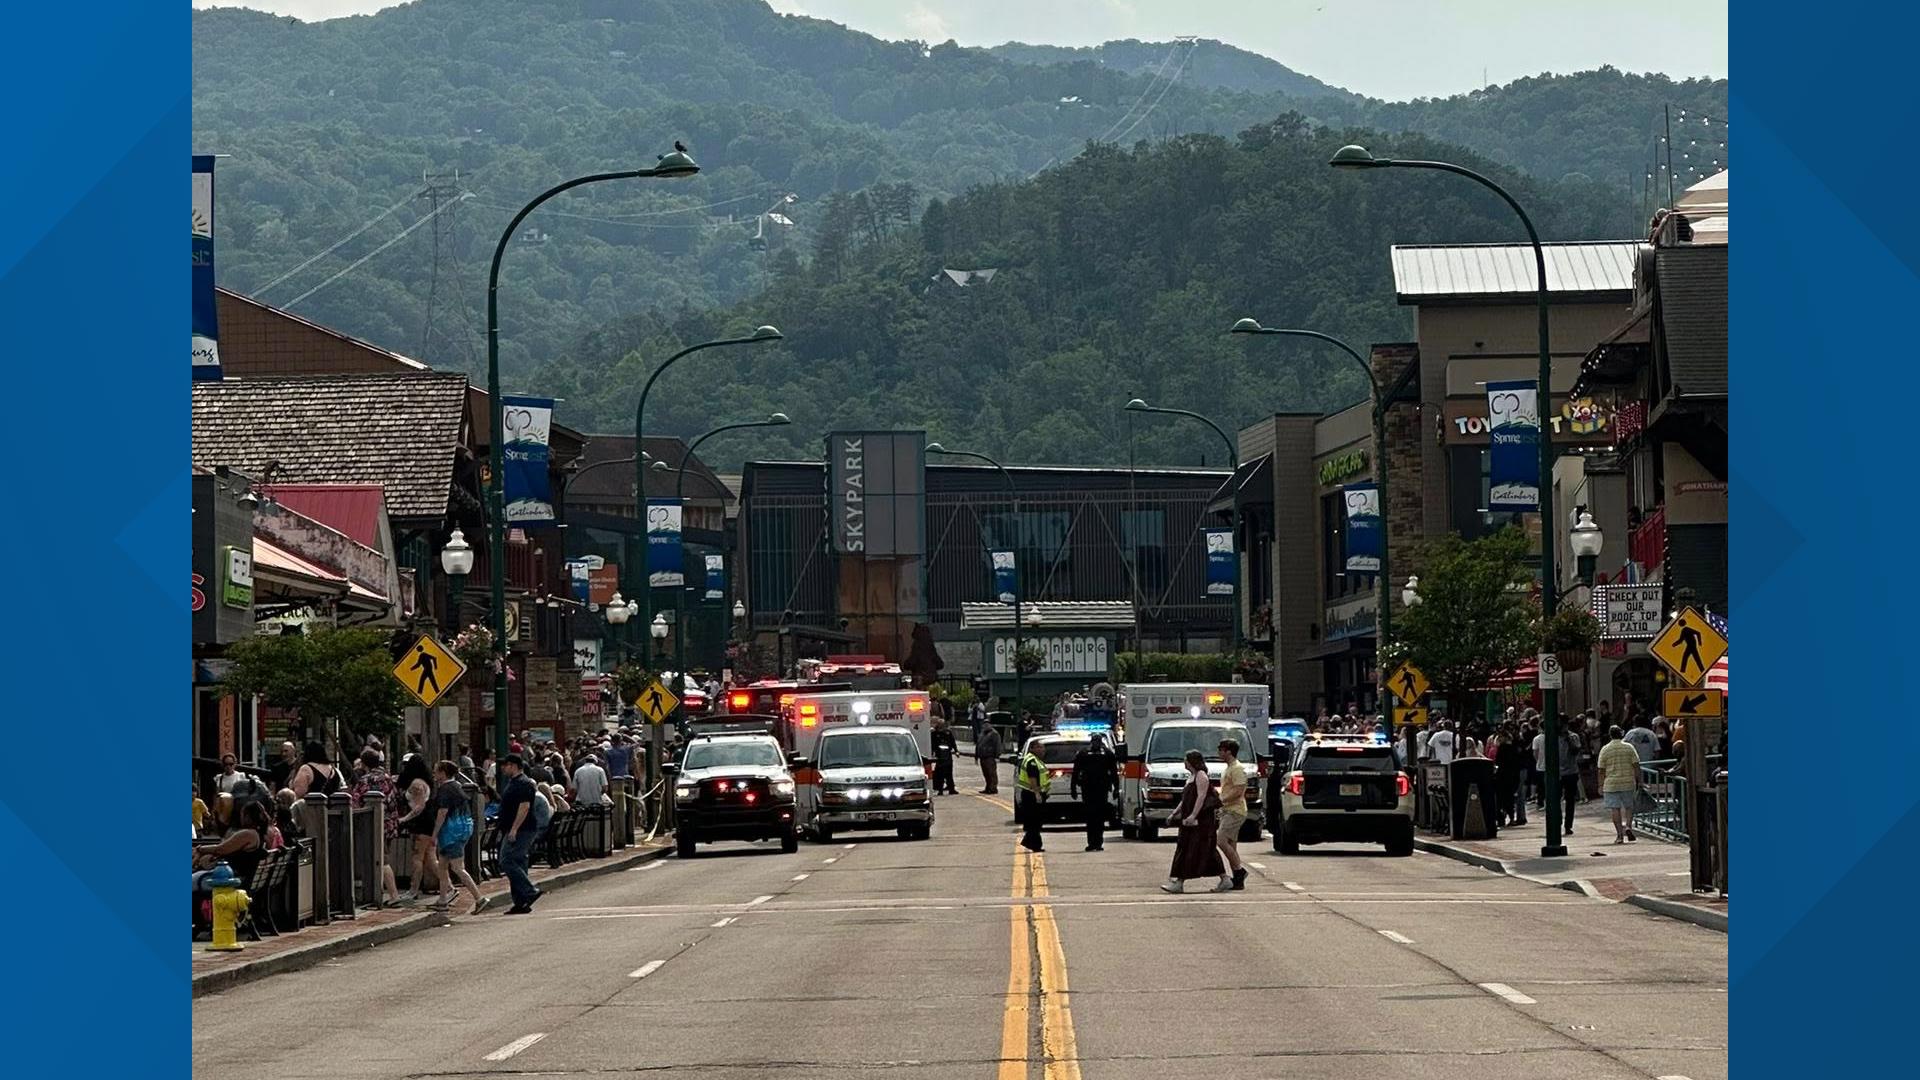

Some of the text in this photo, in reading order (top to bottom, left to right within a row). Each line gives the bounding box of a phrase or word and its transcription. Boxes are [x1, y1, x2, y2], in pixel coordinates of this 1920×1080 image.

[845, 437, 864, 552] SKYPARK
[1609, 590, 1659, 602] CHECK OUT
[1626, 602, 1644, 611] OUR
[1611, 611, 1658, 622] ROOF TOP
[1620, 622, 1648, 632] PATIO
[875, 713, 904, 721] COUNTY
